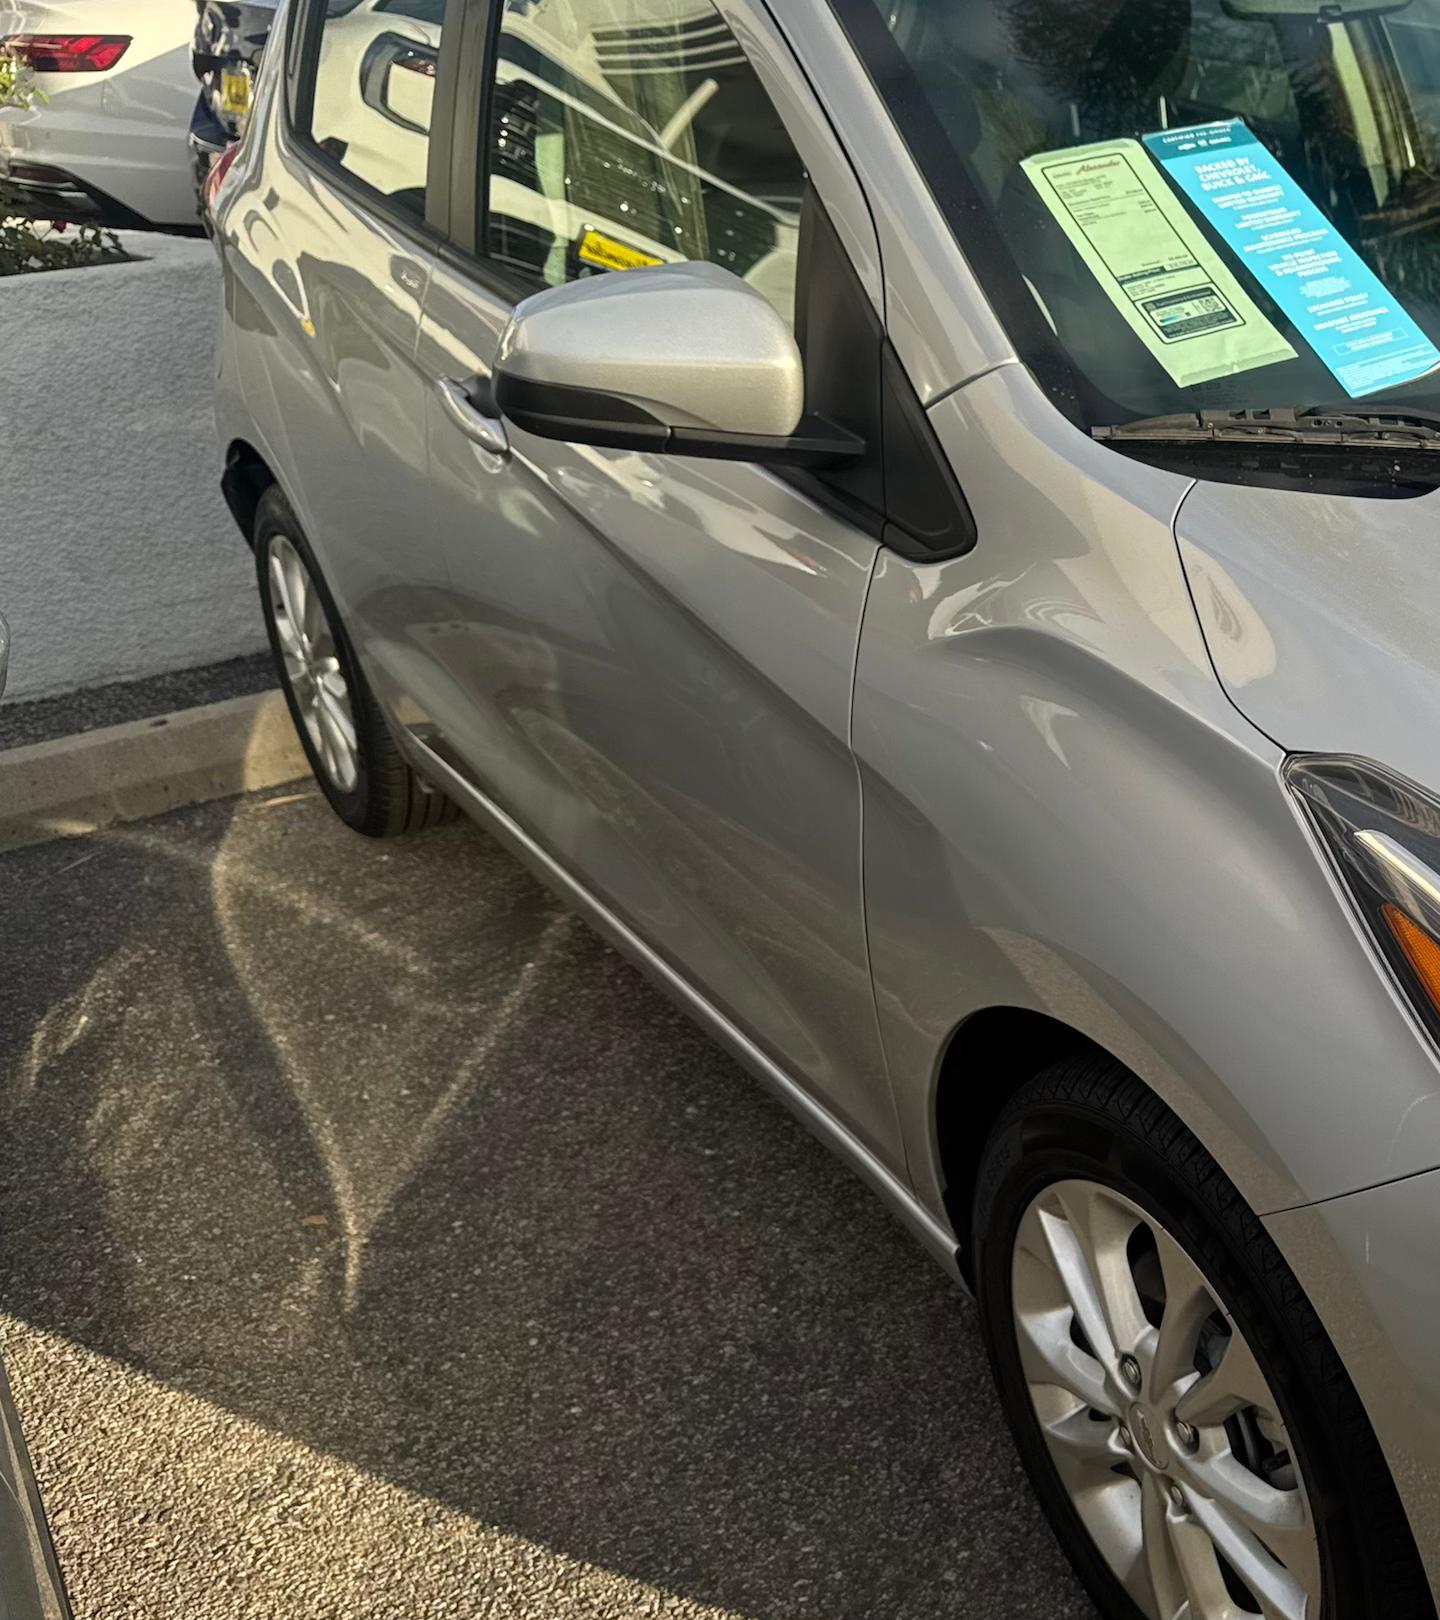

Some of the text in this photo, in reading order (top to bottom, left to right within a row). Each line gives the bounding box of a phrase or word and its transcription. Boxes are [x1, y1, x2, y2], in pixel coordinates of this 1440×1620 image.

[1194, 156, 1250, 174] BACKED BY
[1201, 178, 1234, 191] BUICK
[1234, 175, 1245, 185] &
